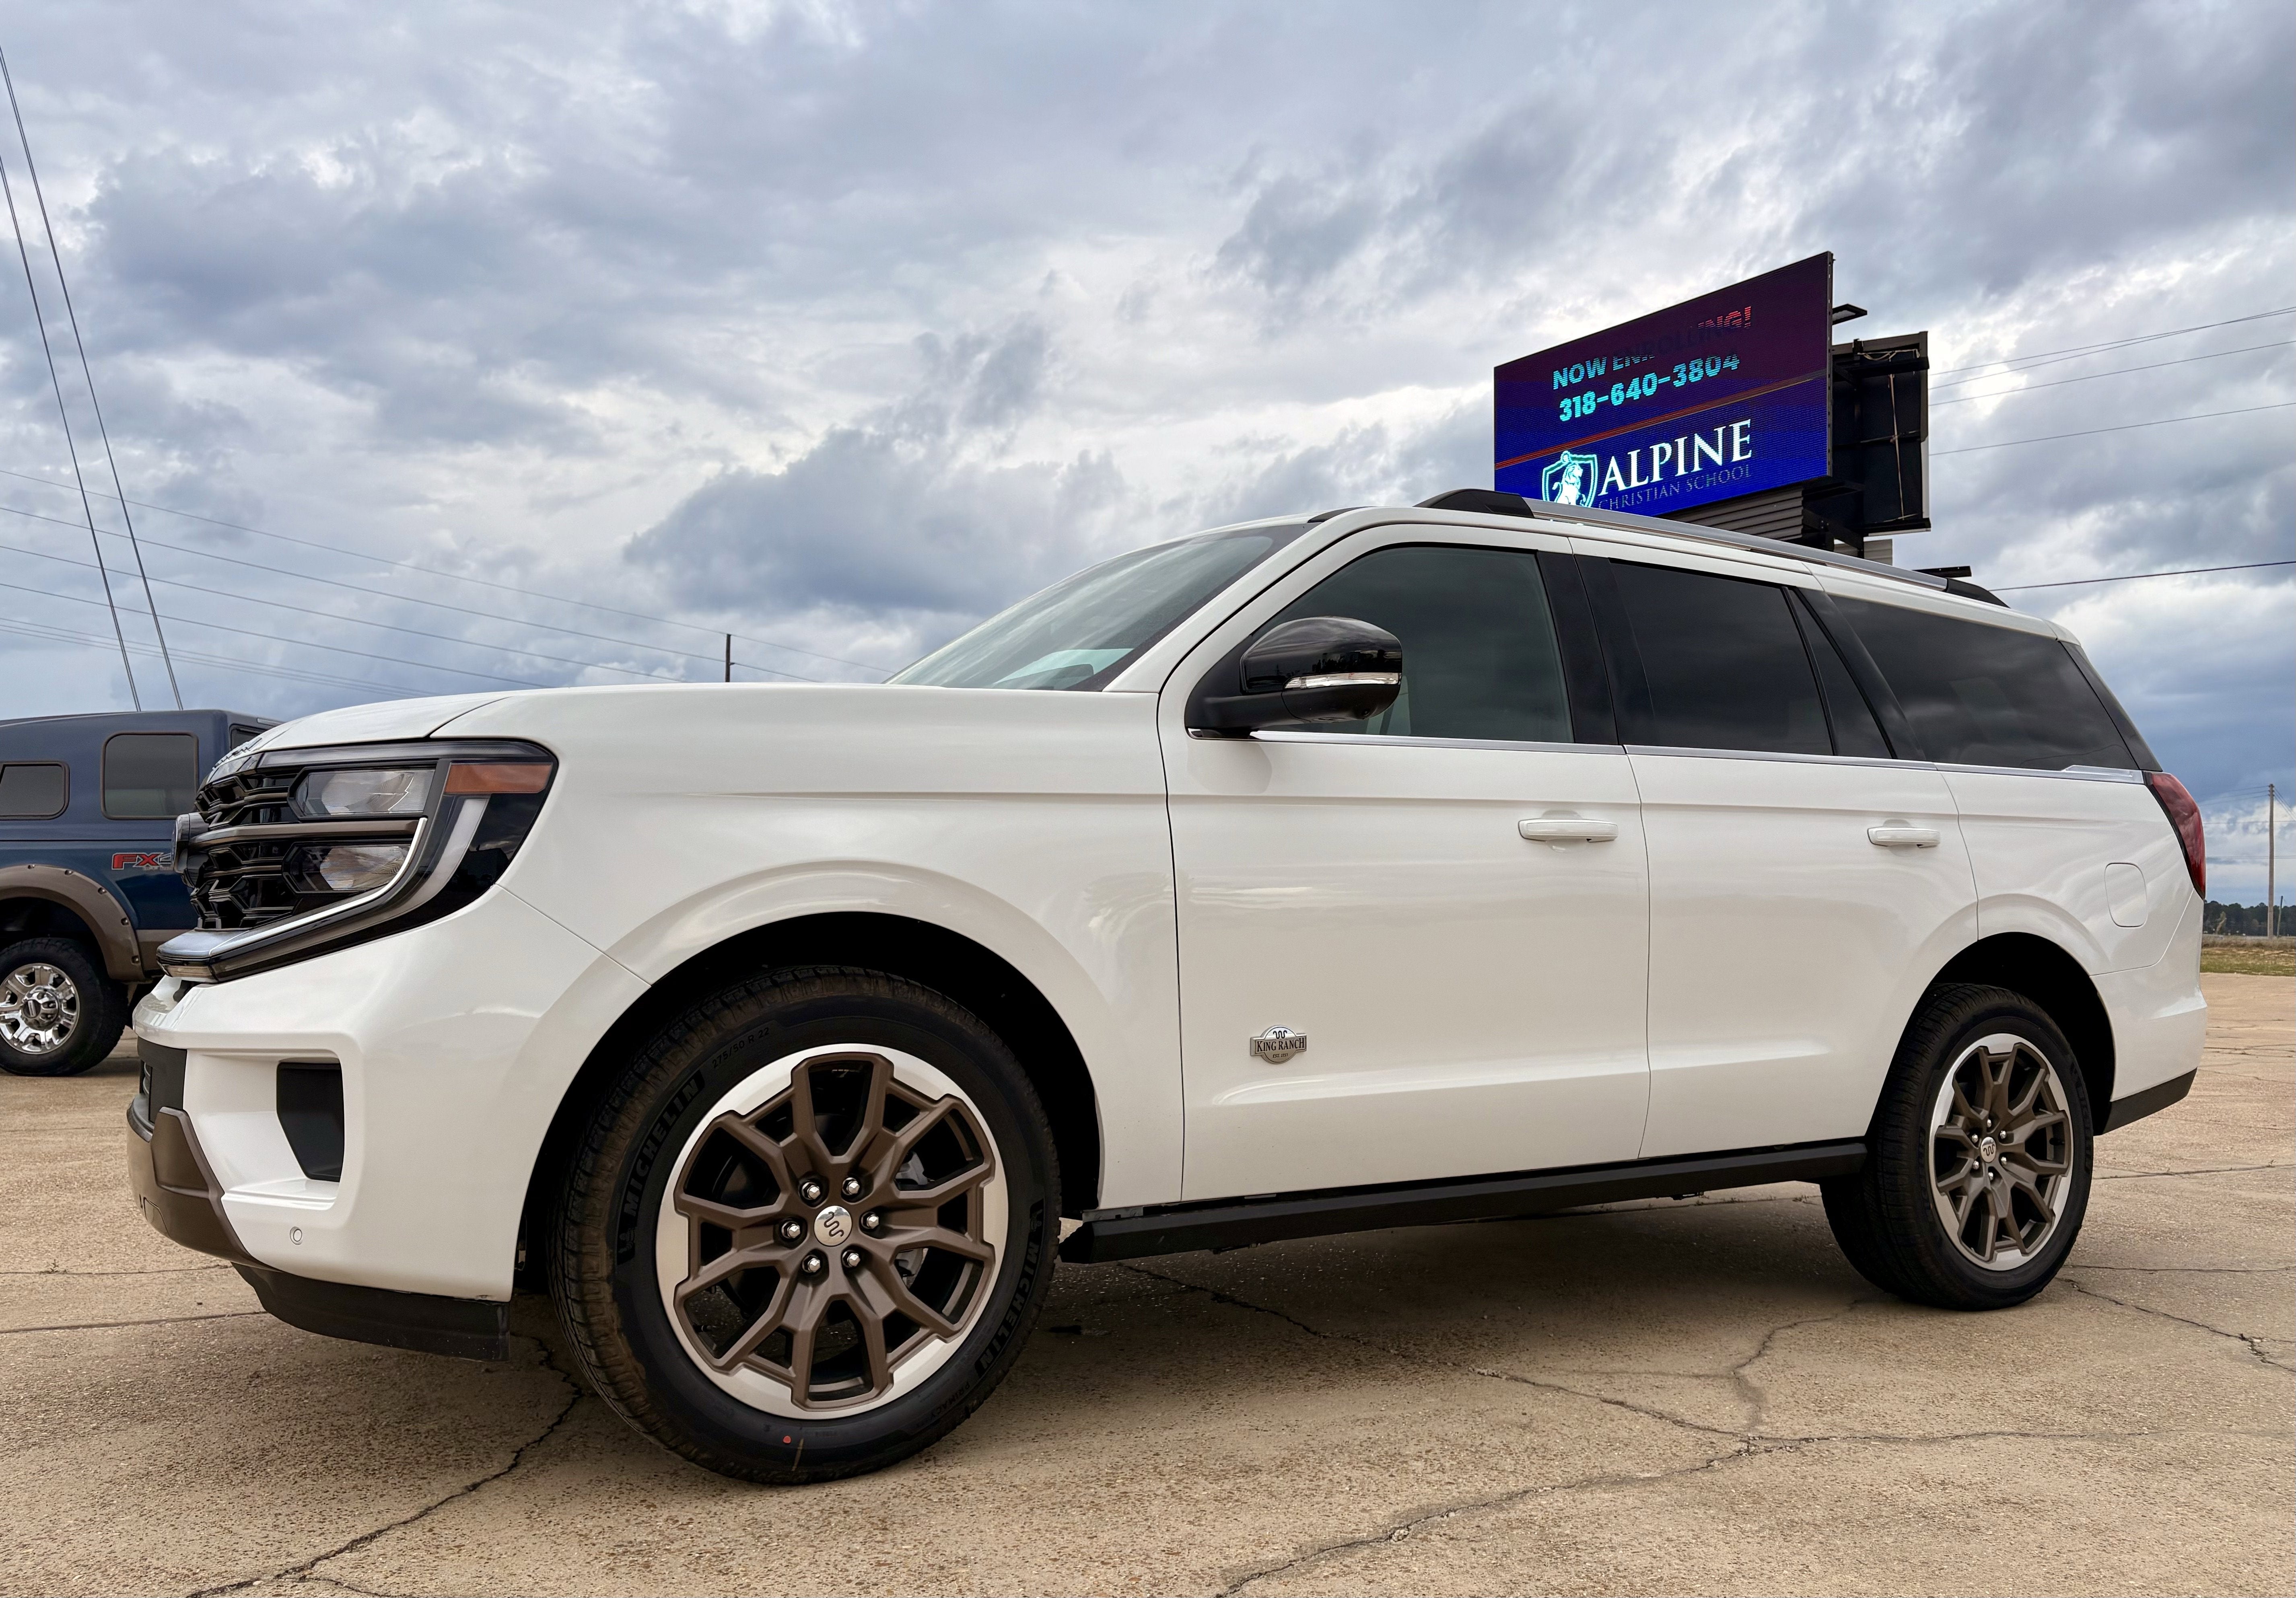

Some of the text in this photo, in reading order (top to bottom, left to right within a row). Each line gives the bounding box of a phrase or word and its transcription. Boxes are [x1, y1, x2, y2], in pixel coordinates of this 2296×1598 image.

[1553, 356, 1607, 390] NOW
[1559, 354, 1740, 422] 318-640-3804
[1598, 419, 1752, 496] ALPINE
[1598, 464, 1752, 510] CHRISTIAN SCHOOL
[712, 1027, 769, 1069] 275/50 R 22
[1257, 1037, 1304, 1052] KING RANCH
[622, 1078, 699, 1217] MICHELIN
[980, 1241, 1040, 1369] MICHELIN
